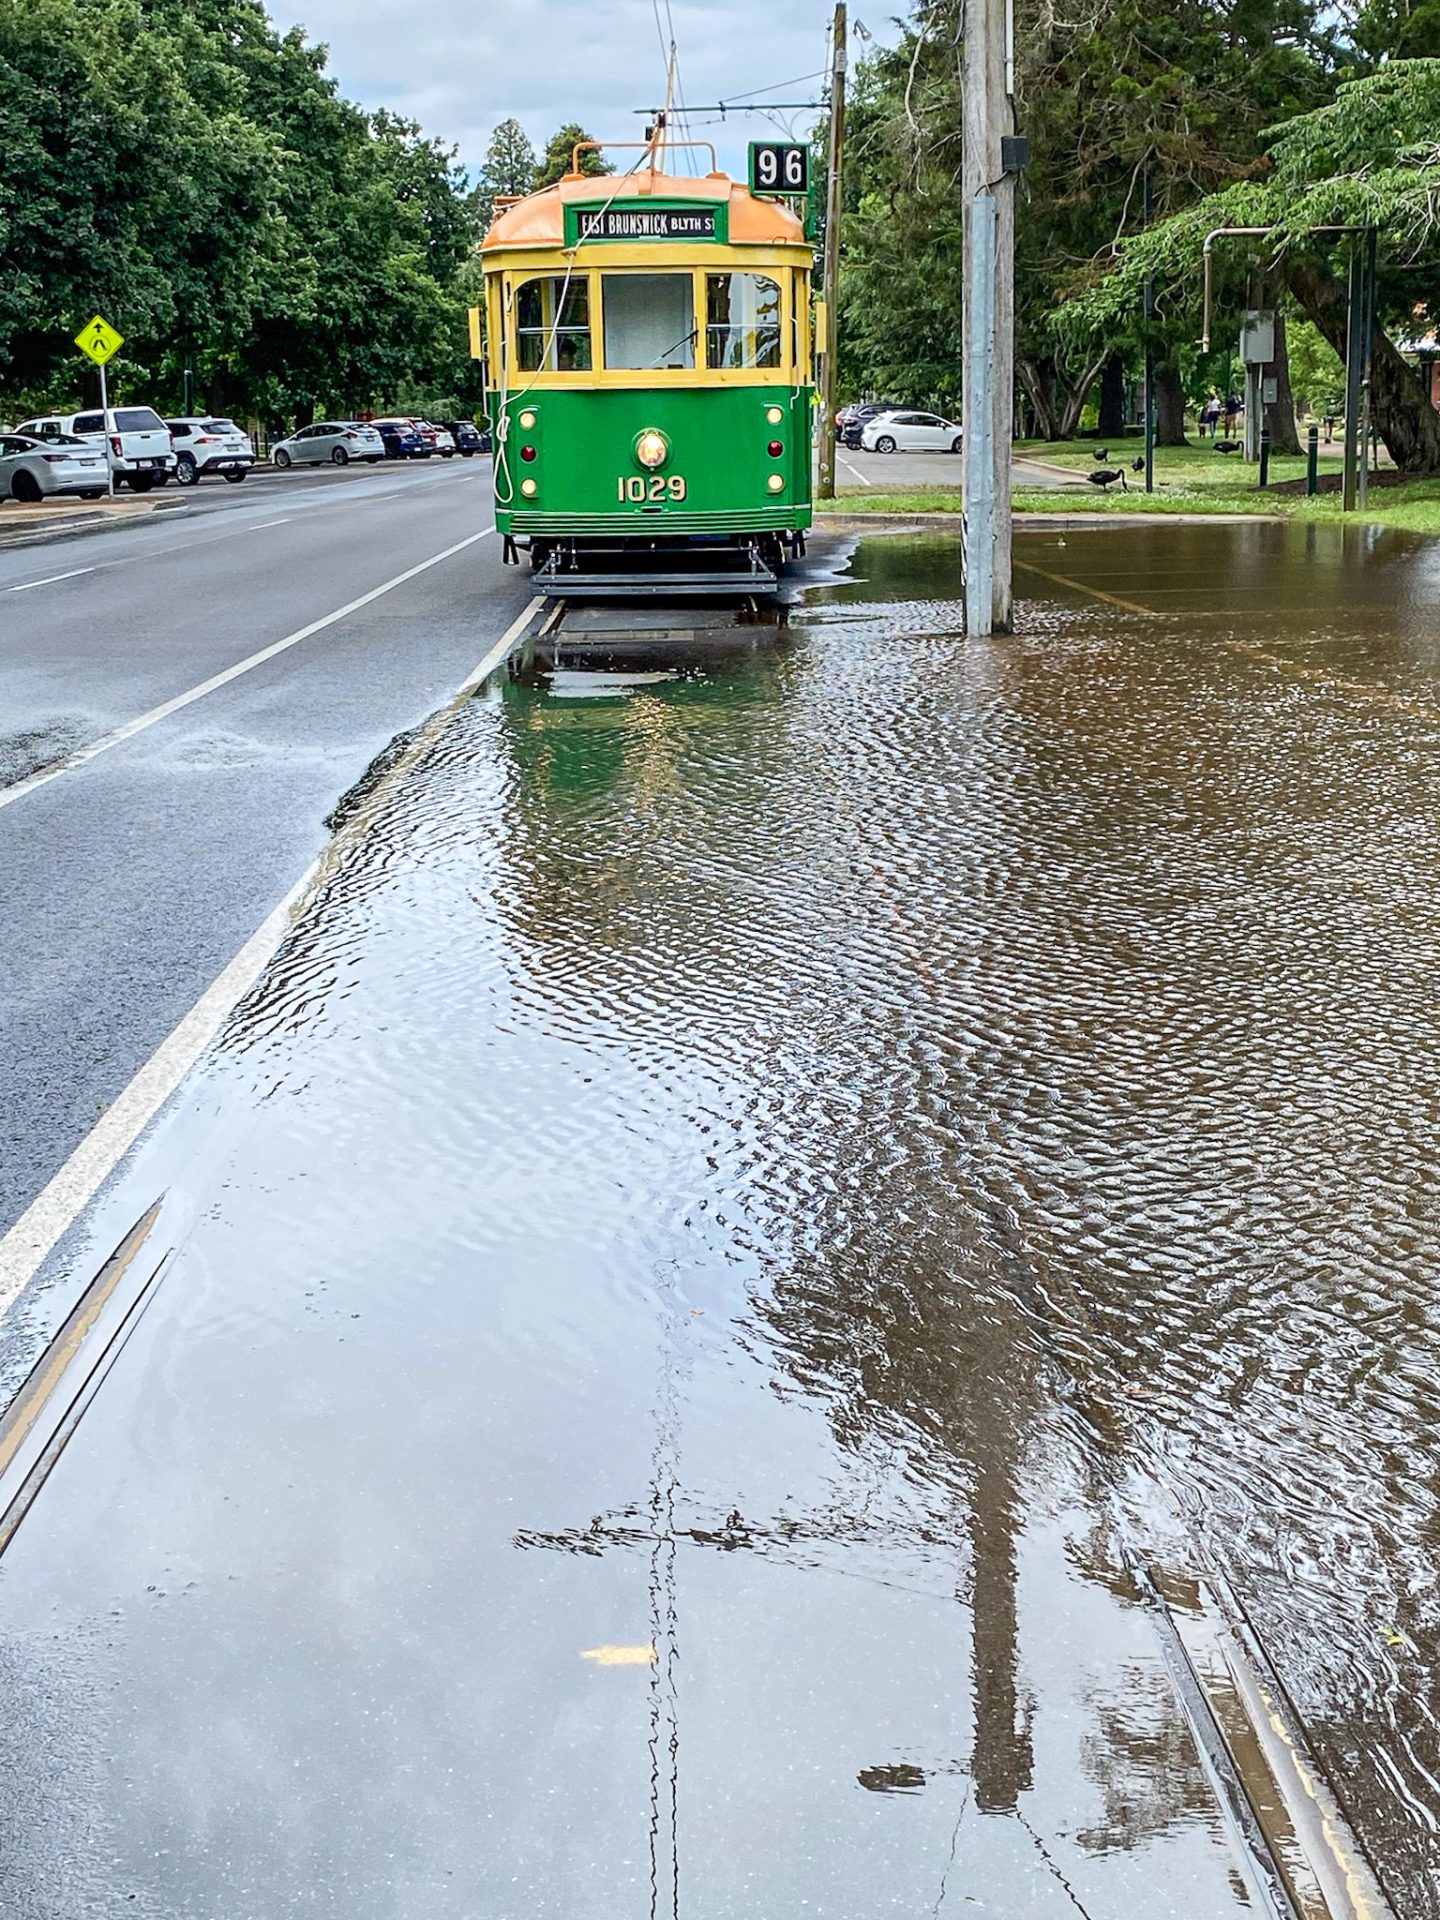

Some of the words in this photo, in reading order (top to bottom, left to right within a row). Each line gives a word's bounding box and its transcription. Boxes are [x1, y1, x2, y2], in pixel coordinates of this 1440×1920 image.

[758, 149, 802, 185] 96
[608, 214, 668, 235] BRUNSWICK
[670, 217, 702, 231] BLYTH
[618, 475, 687, 503] 1029
